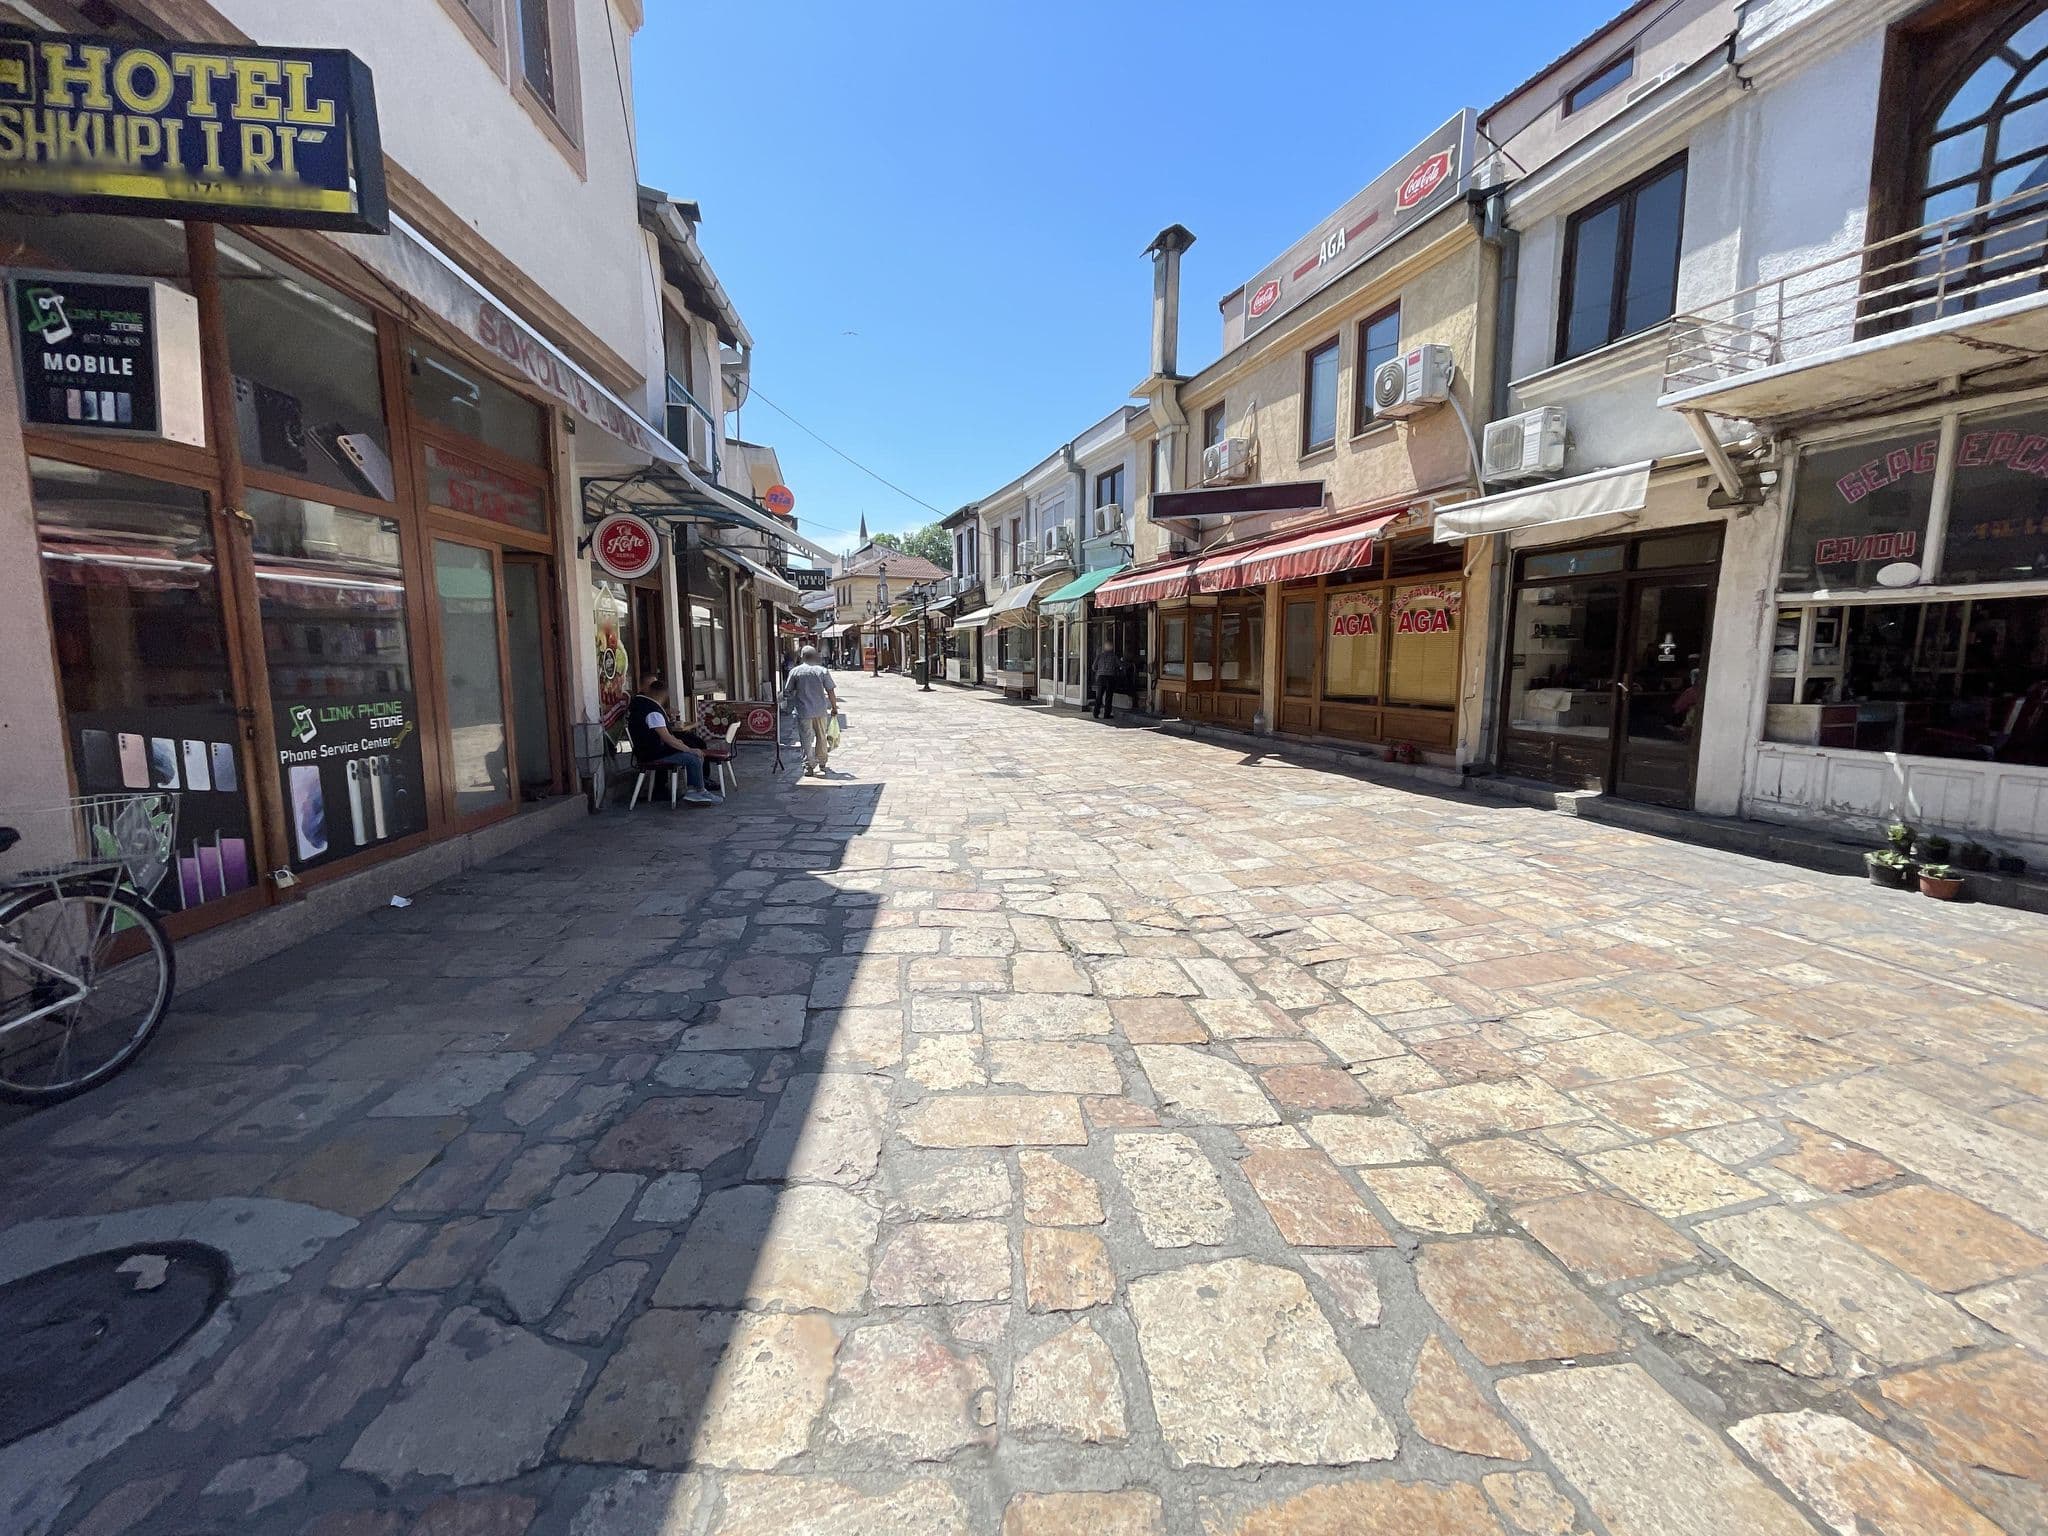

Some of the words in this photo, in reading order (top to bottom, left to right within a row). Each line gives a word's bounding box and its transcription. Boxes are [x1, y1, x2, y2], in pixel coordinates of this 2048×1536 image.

[41, 42, 336, 127] HOTEL
[200, 120, 224, 173] I
[1318, 227, 1346, 267] AGA
[110, 322, 144, 333] STORE
[43, 352, 134, 376] MOBILE
[768, 492, 791, 505] Ria
[1815, 531, 1916, 565] САЛОН
[1332, 614, 1374, 637] AGA
[1396, 608, 1450, 635] AGA
[320, 704, 357, 722] LINK
[358, 701, 403, 719] PHONE
[370, 715, 404, 730] STORE
[280, 747, 318, 765] Phone
[320, 740, 360, 758] Service
[361, 735, 392, 751] Center
